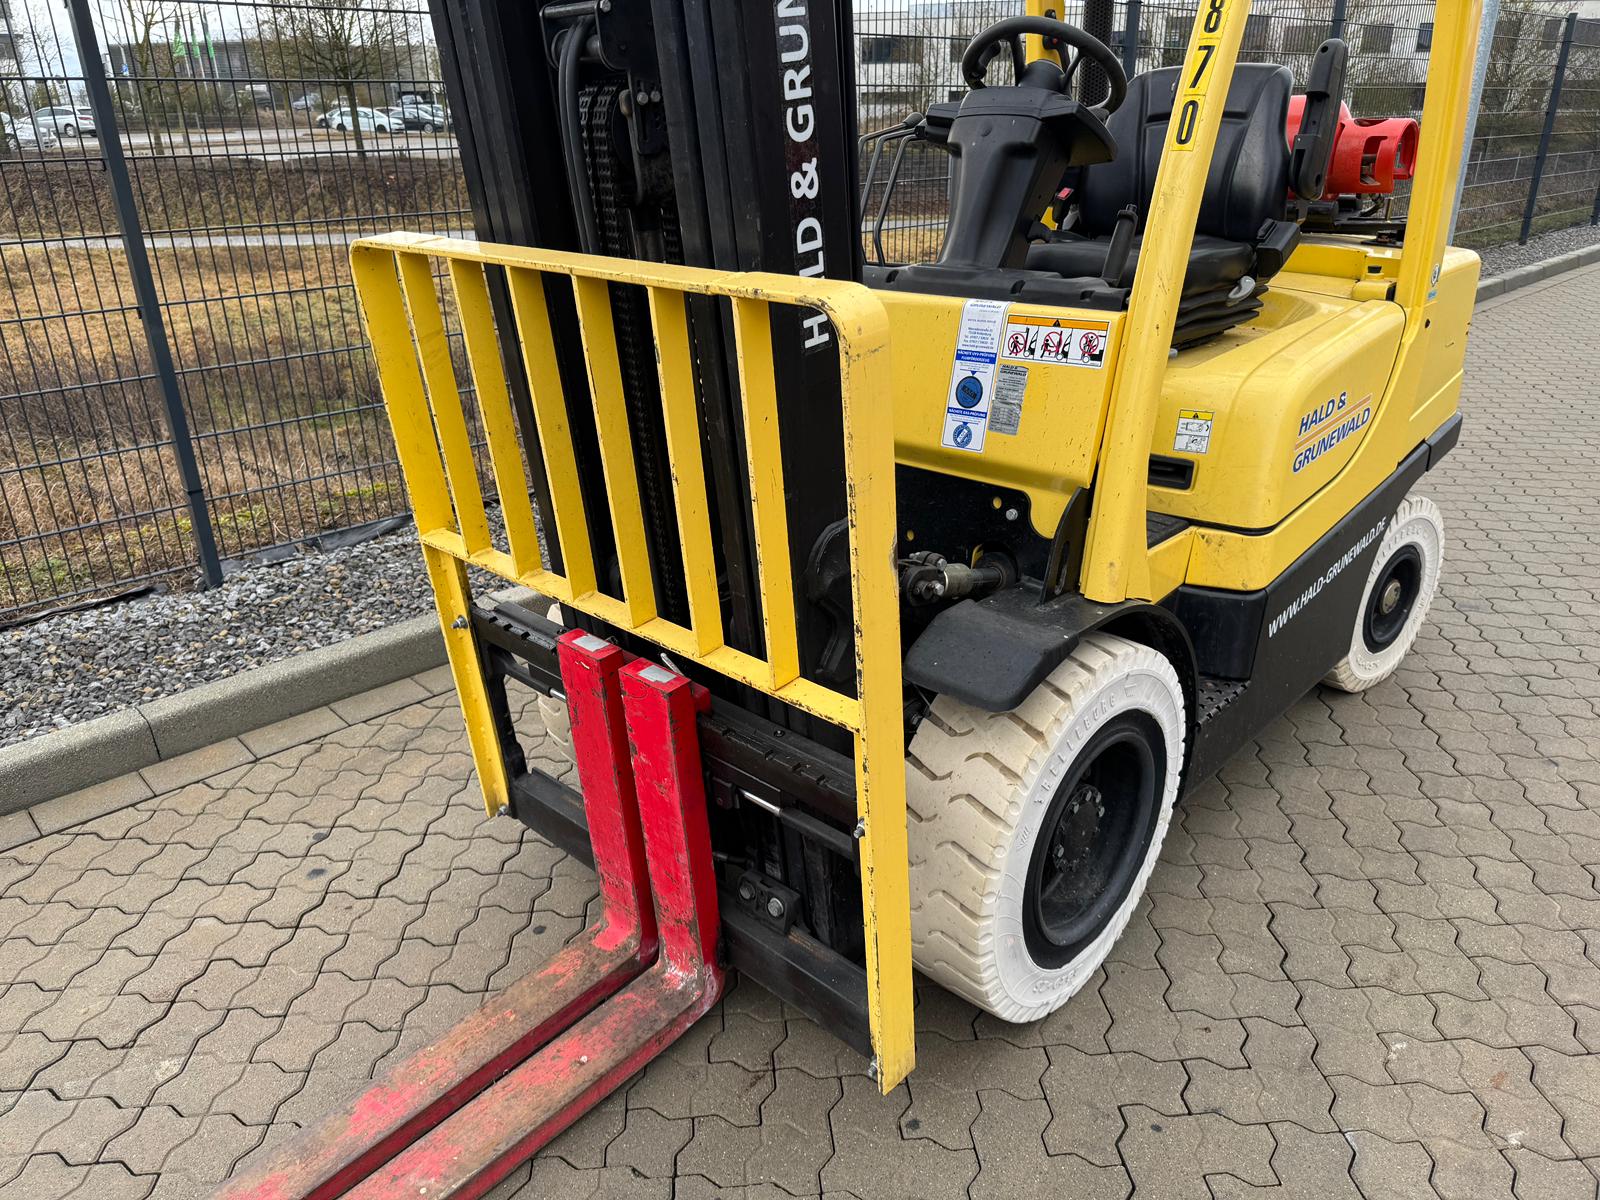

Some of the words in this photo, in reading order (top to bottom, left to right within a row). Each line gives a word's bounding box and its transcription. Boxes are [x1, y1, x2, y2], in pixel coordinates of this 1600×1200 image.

[791, 157, 819, 200] &
[797, 216, 829, 349] HLD
[1292, 407, 1371, 473] GRUNEWALD
[1298, 398, 1335, 436] HALD
[1337, 391, 1347, 410] &
[1268, 516, 1387, 638] WWW.HALD-GRUNEWALD.DE
